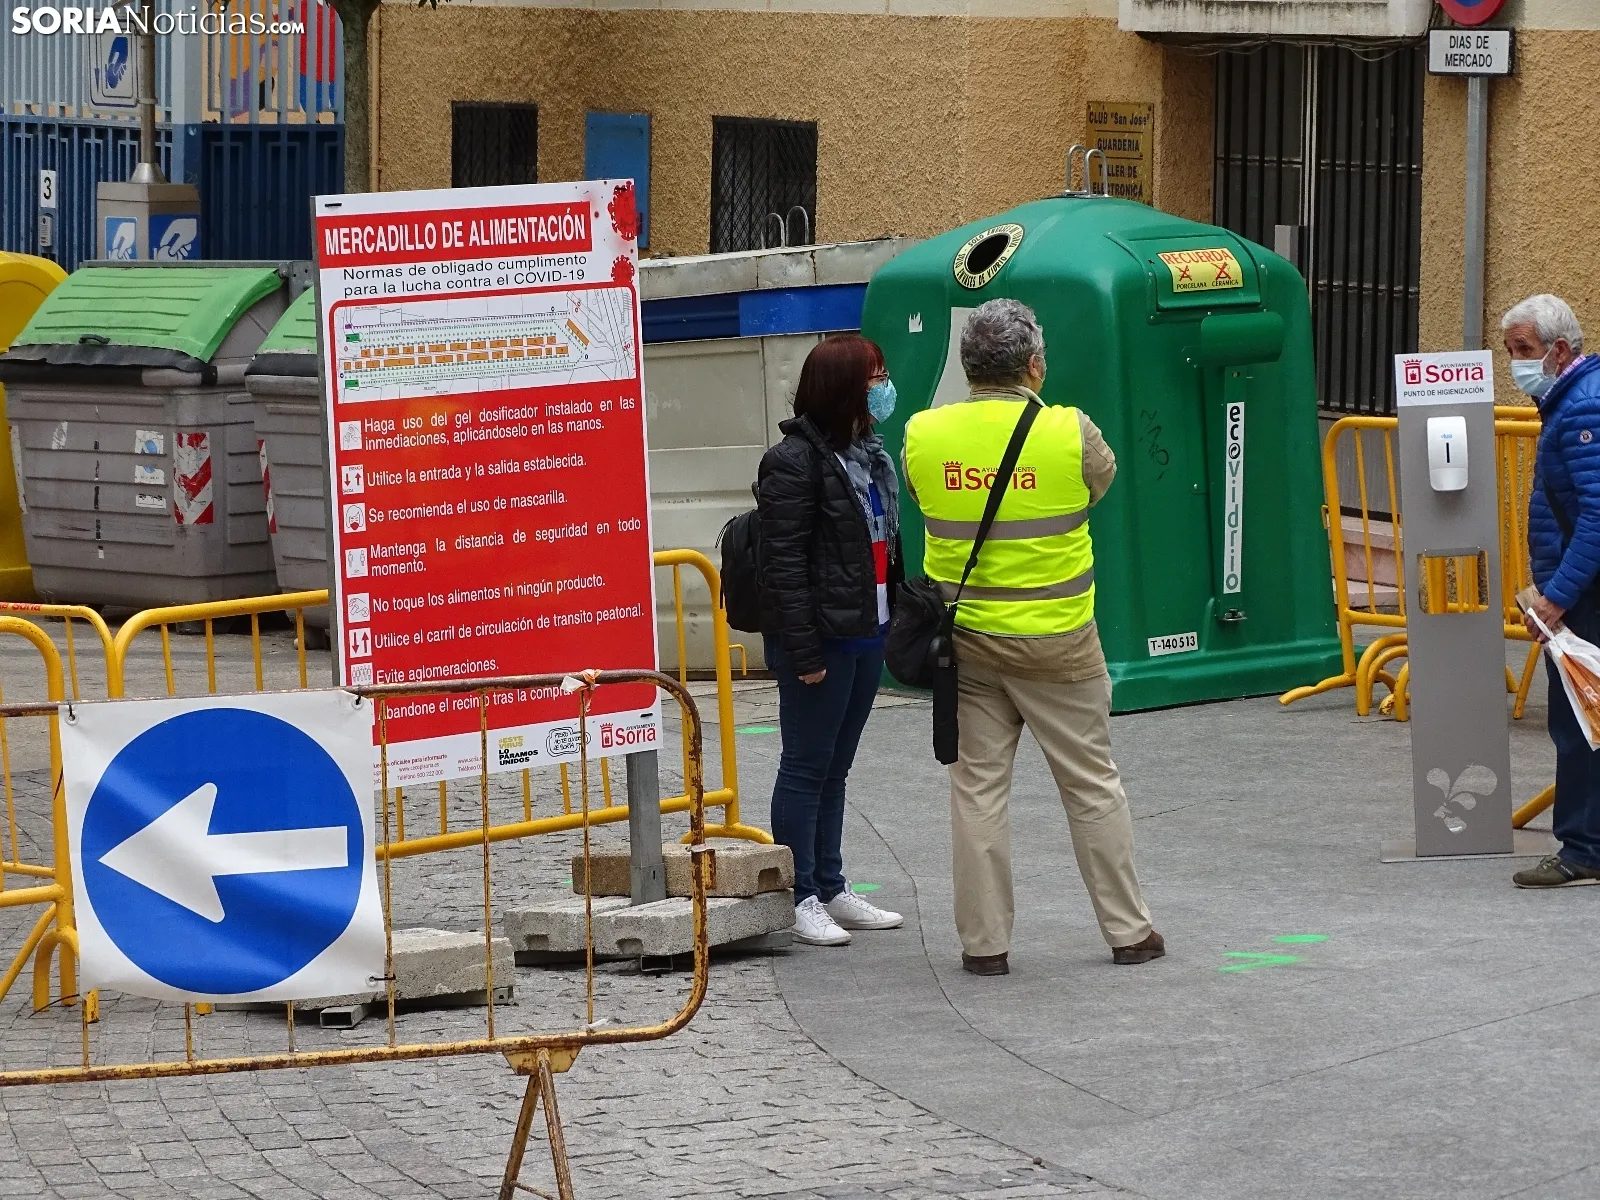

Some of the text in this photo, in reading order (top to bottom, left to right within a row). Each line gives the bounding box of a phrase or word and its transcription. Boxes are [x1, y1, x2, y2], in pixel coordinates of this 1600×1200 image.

[1450, 36, 1490, 49] DIAS DE
[1444, 54, 1492, 68] MERCADO
[1089, 112, 1108, 124] CLUB
[1098, 164, 1138, 178] TLLER DE
[44, 176, 52, 200] 3
[324, 206, 586, 256] MERCADILLO DE ALIMENTACIÓN
[344, 255, 588, 281] Normas de obligado cumplimento
[1162, 250, 1234, 264] RECUERDA
[344, 268, 586, 298] para la lucha contra el COVID-19
[1426, 364, 1484, 383] Soria
[1438, 386, 1484, 396] HIGIENIZACIÓN
[364, 396, 635, 436] Haga uso del gel dosificador instalado en las
[364, 418, 604, 452] inmediaciones, aplicándoselo en las manos.
[367, 453, 587, 488] Utilice la entrada y la salida establecida.
[964, 468, 1037, 490] Soia
[368, 490, 568, 523] Se recomienda el uso de mascarilla.
[370, 517, 642, 558] Mantenga la distancia de seguridad en todo
[372, 560, 427, 577] momento.
[373, 574, 606, 612] No toque los alimentos ni ningún producto.
[374, 603, 645, 650] Utilice el carril de circulación de transito peatonal.
[376, 659, 500, 684] Evite aglomeraciones.
[439, 698, 448, 712] el
[452, 694, 490, 710] recino
[493, 692, 515, 706] tras
[518, 688, 527, 702] la
[616, 727, 656, 746] Soria
[499, 750, 538, 760] PARAMOS
[500, 756, 530, 766] UNIDOS
